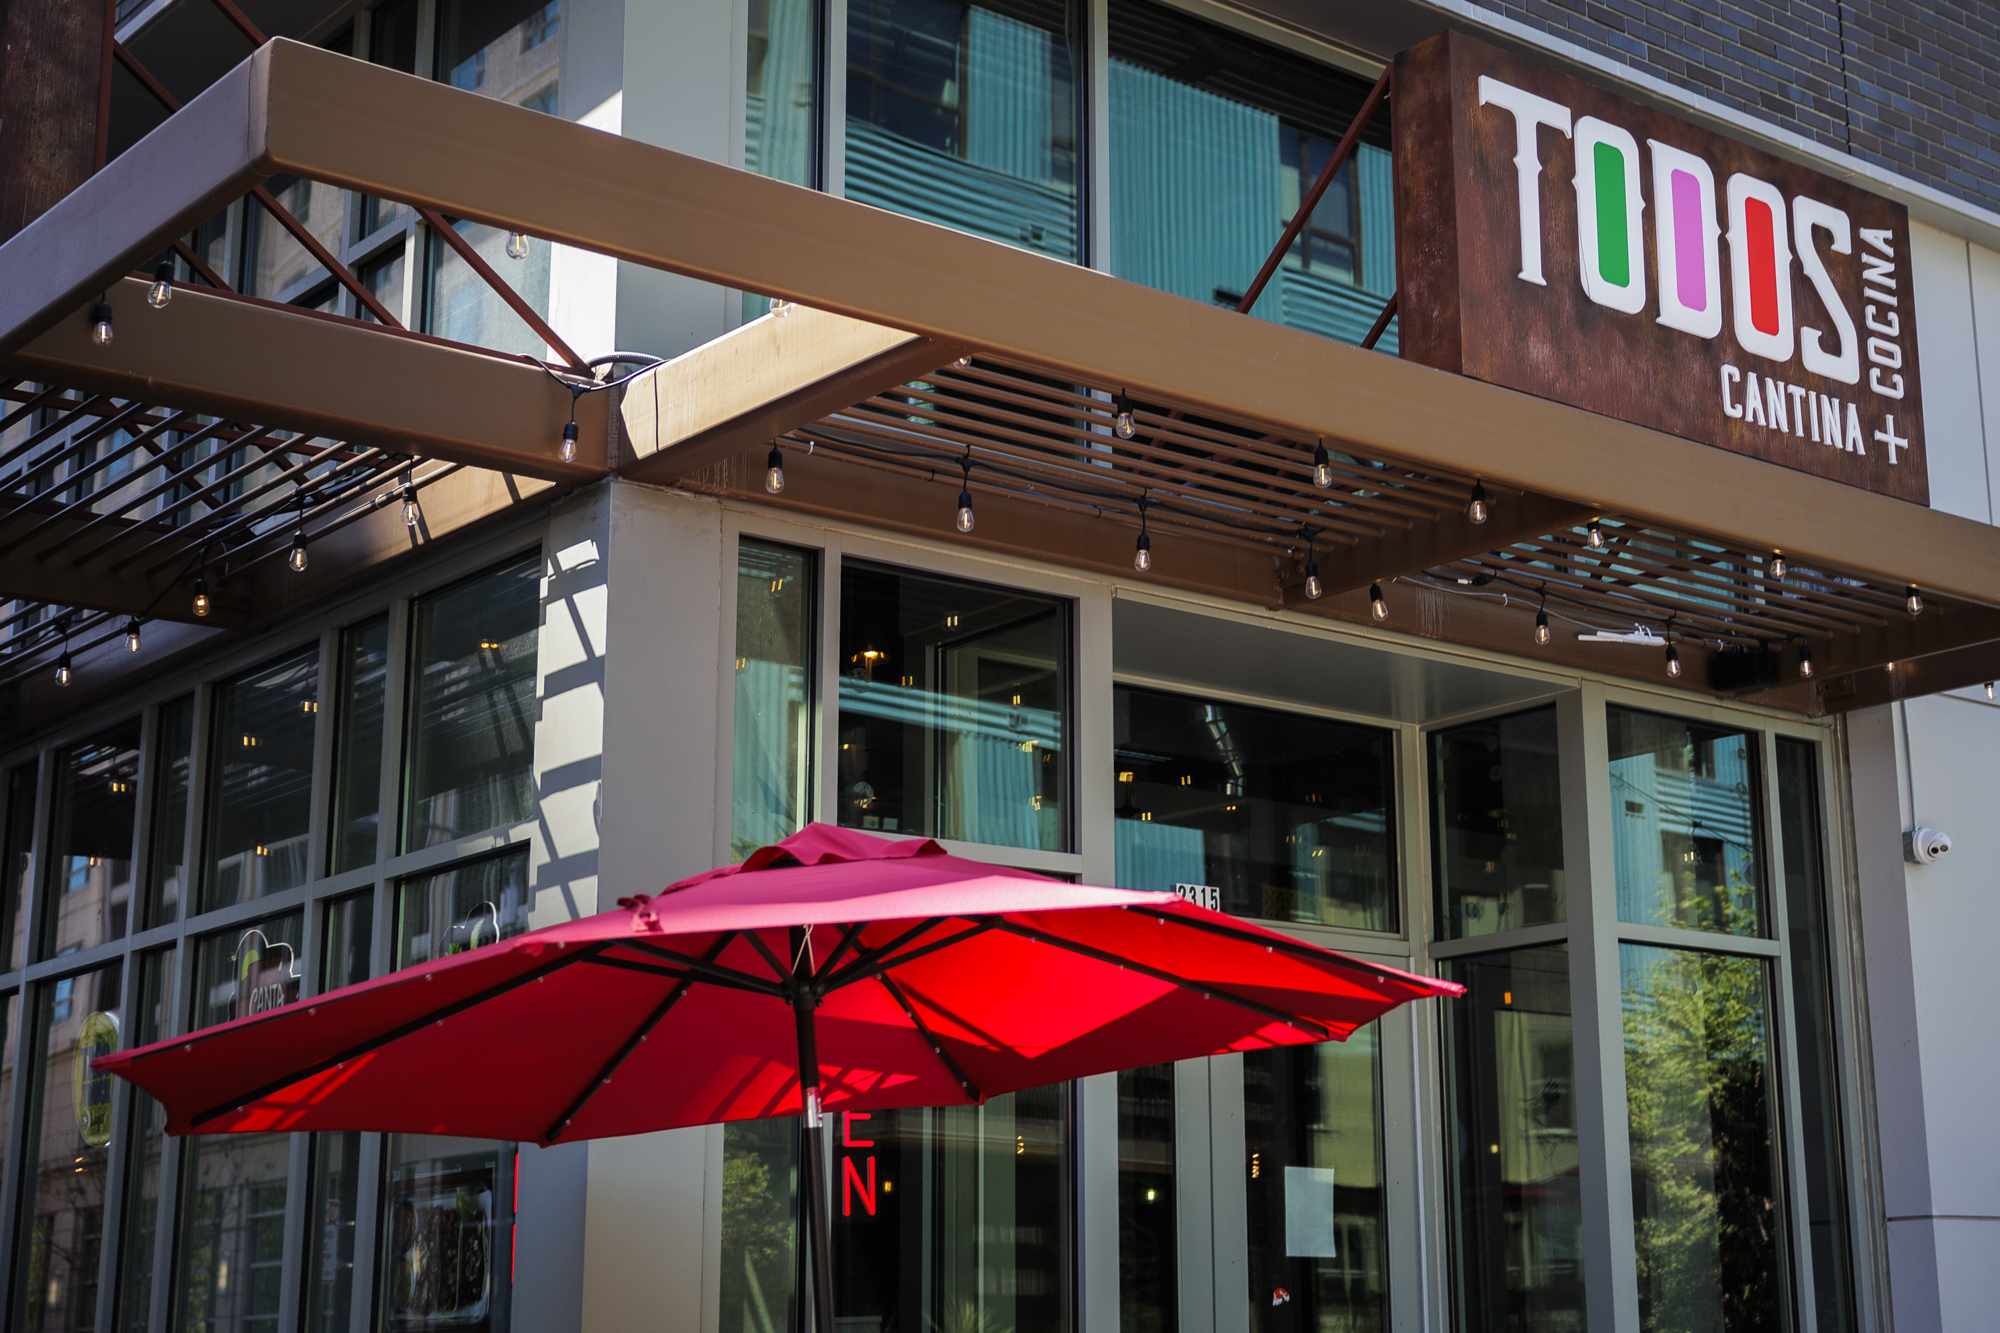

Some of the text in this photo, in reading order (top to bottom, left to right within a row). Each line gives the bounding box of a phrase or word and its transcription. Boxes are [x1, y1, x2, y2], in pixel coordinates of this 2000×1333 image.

[1477, 74, 1860, 385] TODOS
[1859, 226, 1905, 400] COCINA
[1720, 363, 1866, 456] CANTINA
